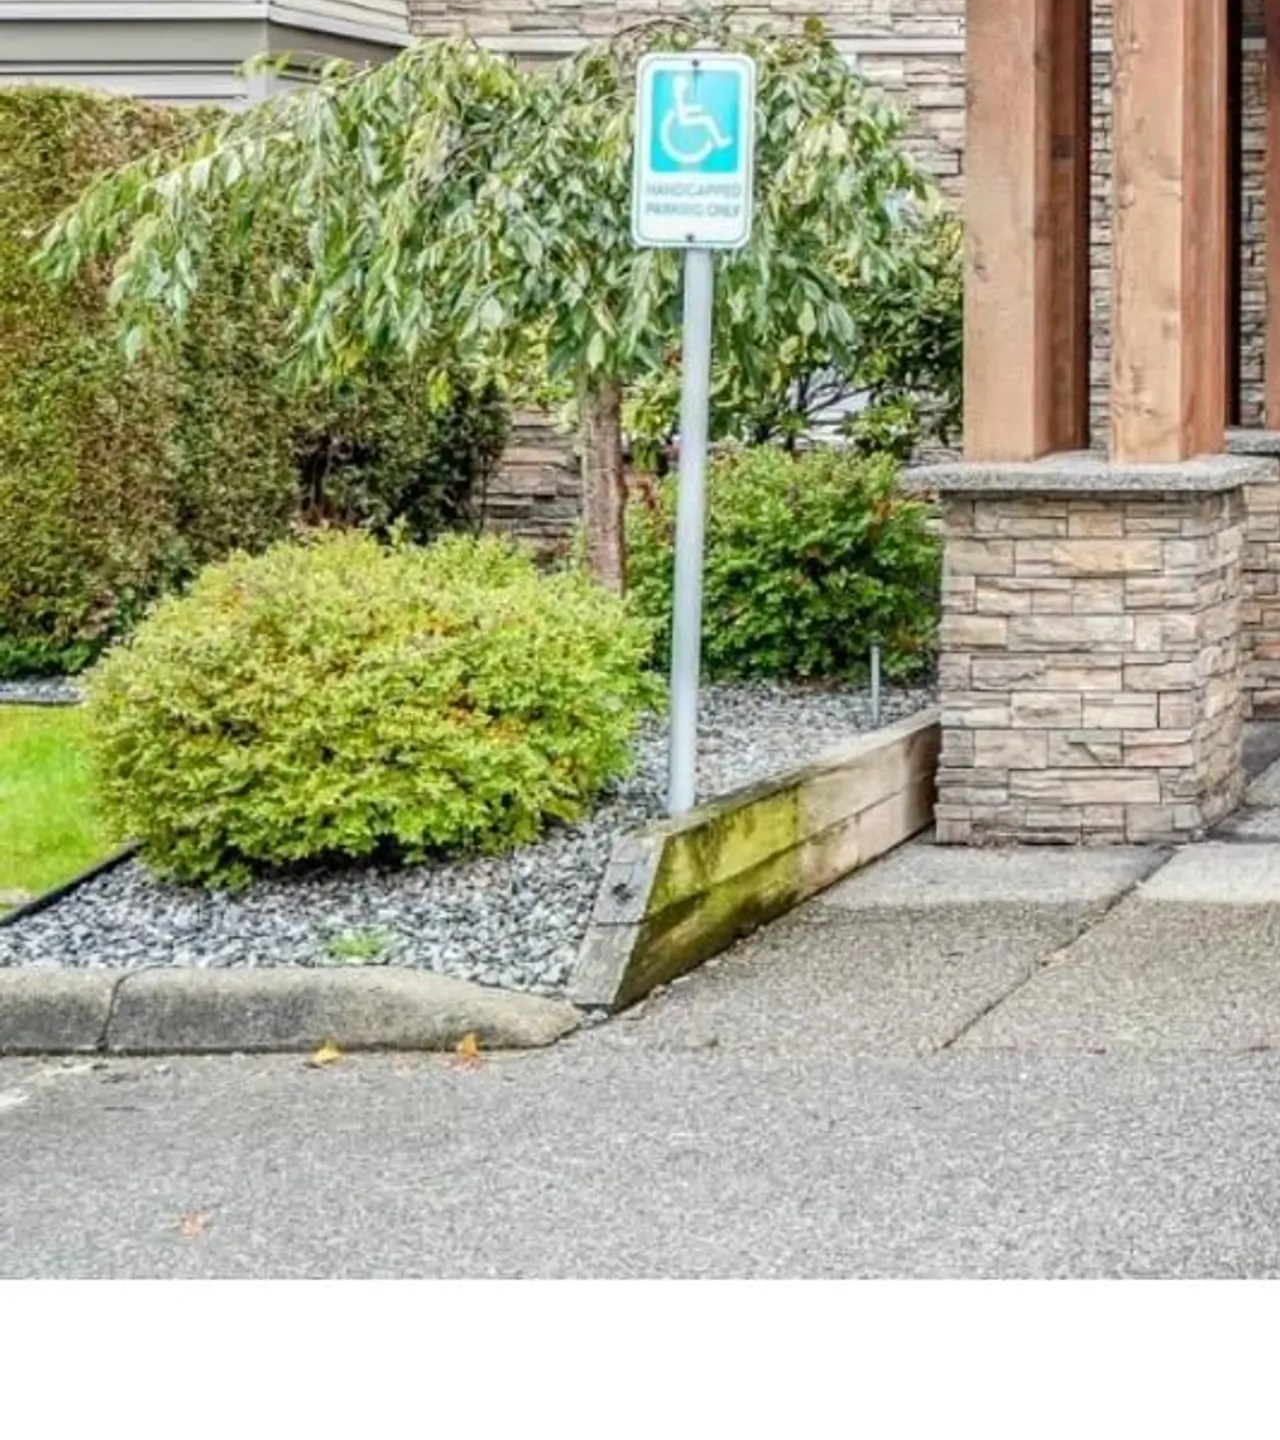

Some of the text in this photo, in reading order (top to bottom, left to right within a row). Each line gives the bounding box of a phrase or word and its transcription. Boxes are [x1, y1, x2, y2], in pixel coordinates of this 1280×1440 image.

[645, 182, 741, 197] HANDICAPPED
[645, 202, 740, 217] PARKING ONLY
